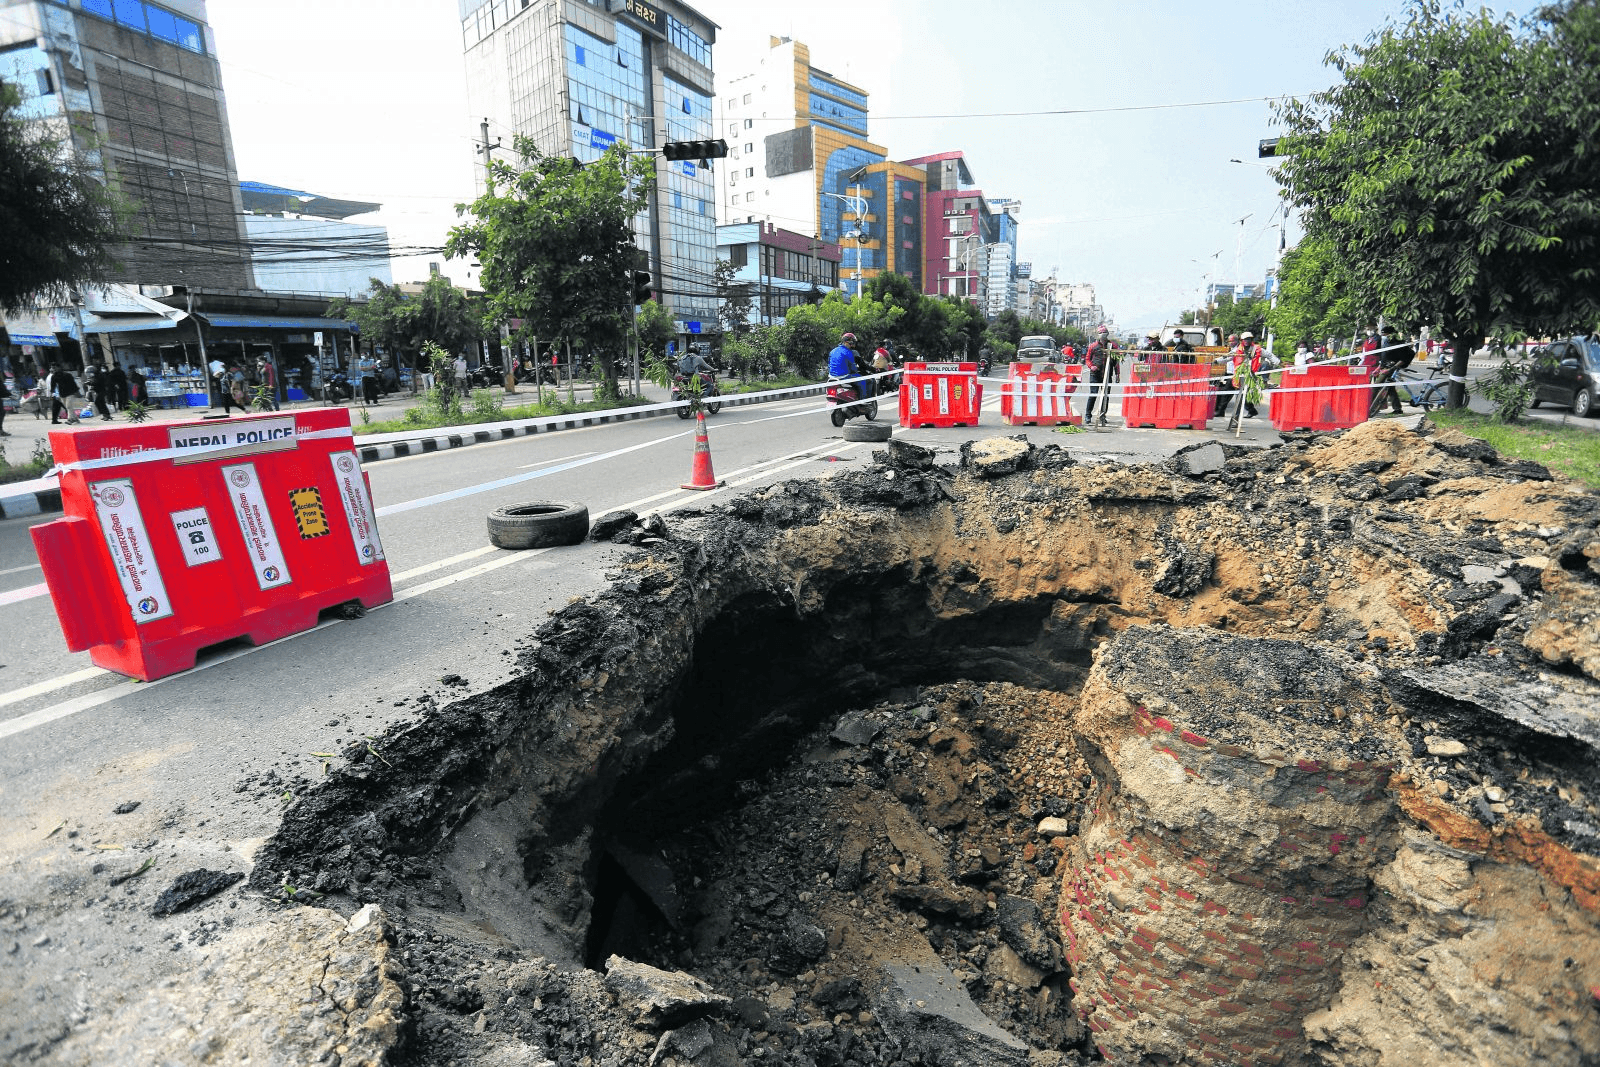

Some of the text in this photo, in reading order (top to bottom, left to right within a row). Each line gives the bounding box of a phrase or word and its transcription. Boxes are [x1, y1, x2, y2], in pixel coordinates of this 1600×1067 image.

[635, 2, 656, 25] लक्ष्य
[175, 434, 227, 448] NEPAL
[236, 427, 292, 444] POLICE
[297, 502, 319, 510] Accident
[176, 517, 208, 530] POLICE
[194, 546, 209, 555] 100
